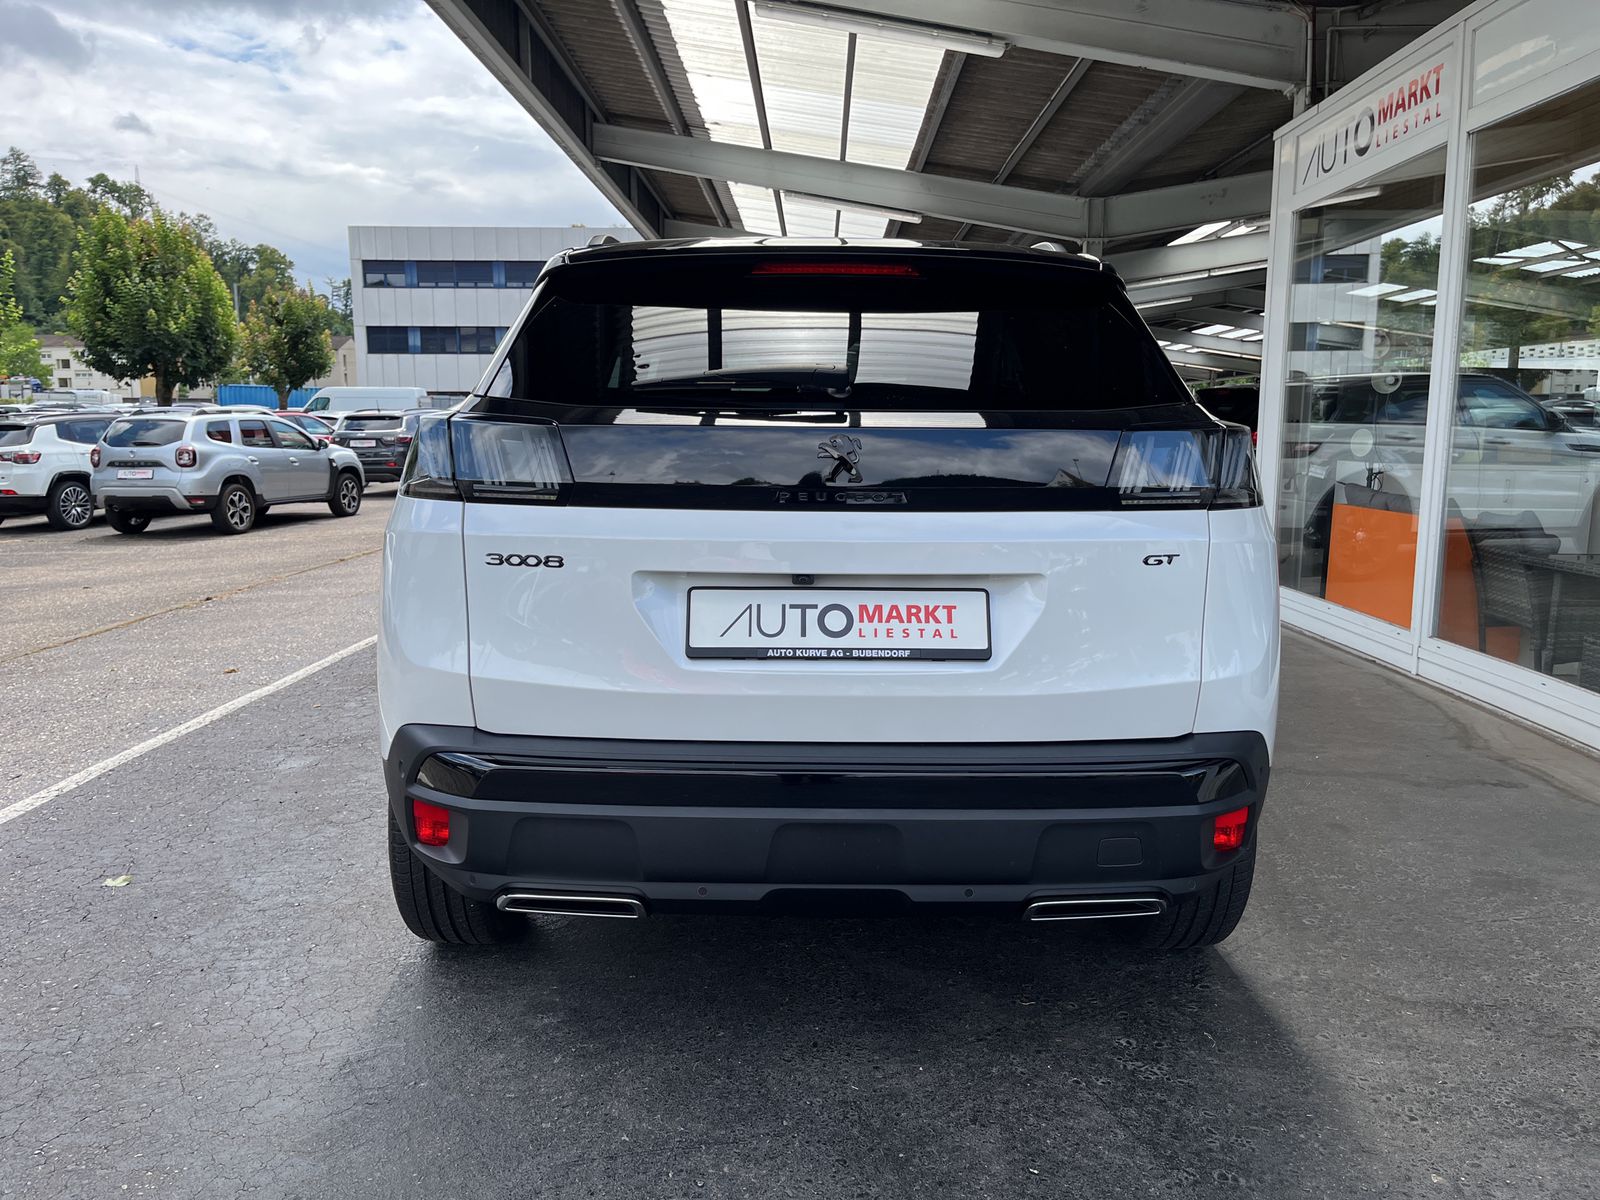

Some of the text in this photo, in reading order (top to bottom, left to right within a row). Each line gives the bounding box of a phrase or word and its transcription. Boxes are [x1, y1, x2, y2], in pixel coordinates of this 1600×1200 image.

[1302, 63, 1445, 185] AUTO MARKT
[1376, 103, 1442, 148] LIESTAL
[779, 492, 907, 504] PEUGEOT
[485, 553, 565, 568] 3008
[1142, 554, 1181, 566] GT
[719, 603, 957, 639] AUTO MARKT
[858, 628, 958, 639] LIESTAL
[767, 649, 793, 657] AUTO
[796, 649, 828, 657] KURVE
[829, 649, 844, 657] AG
[852, 650, 911, 658] BUBENDORF
